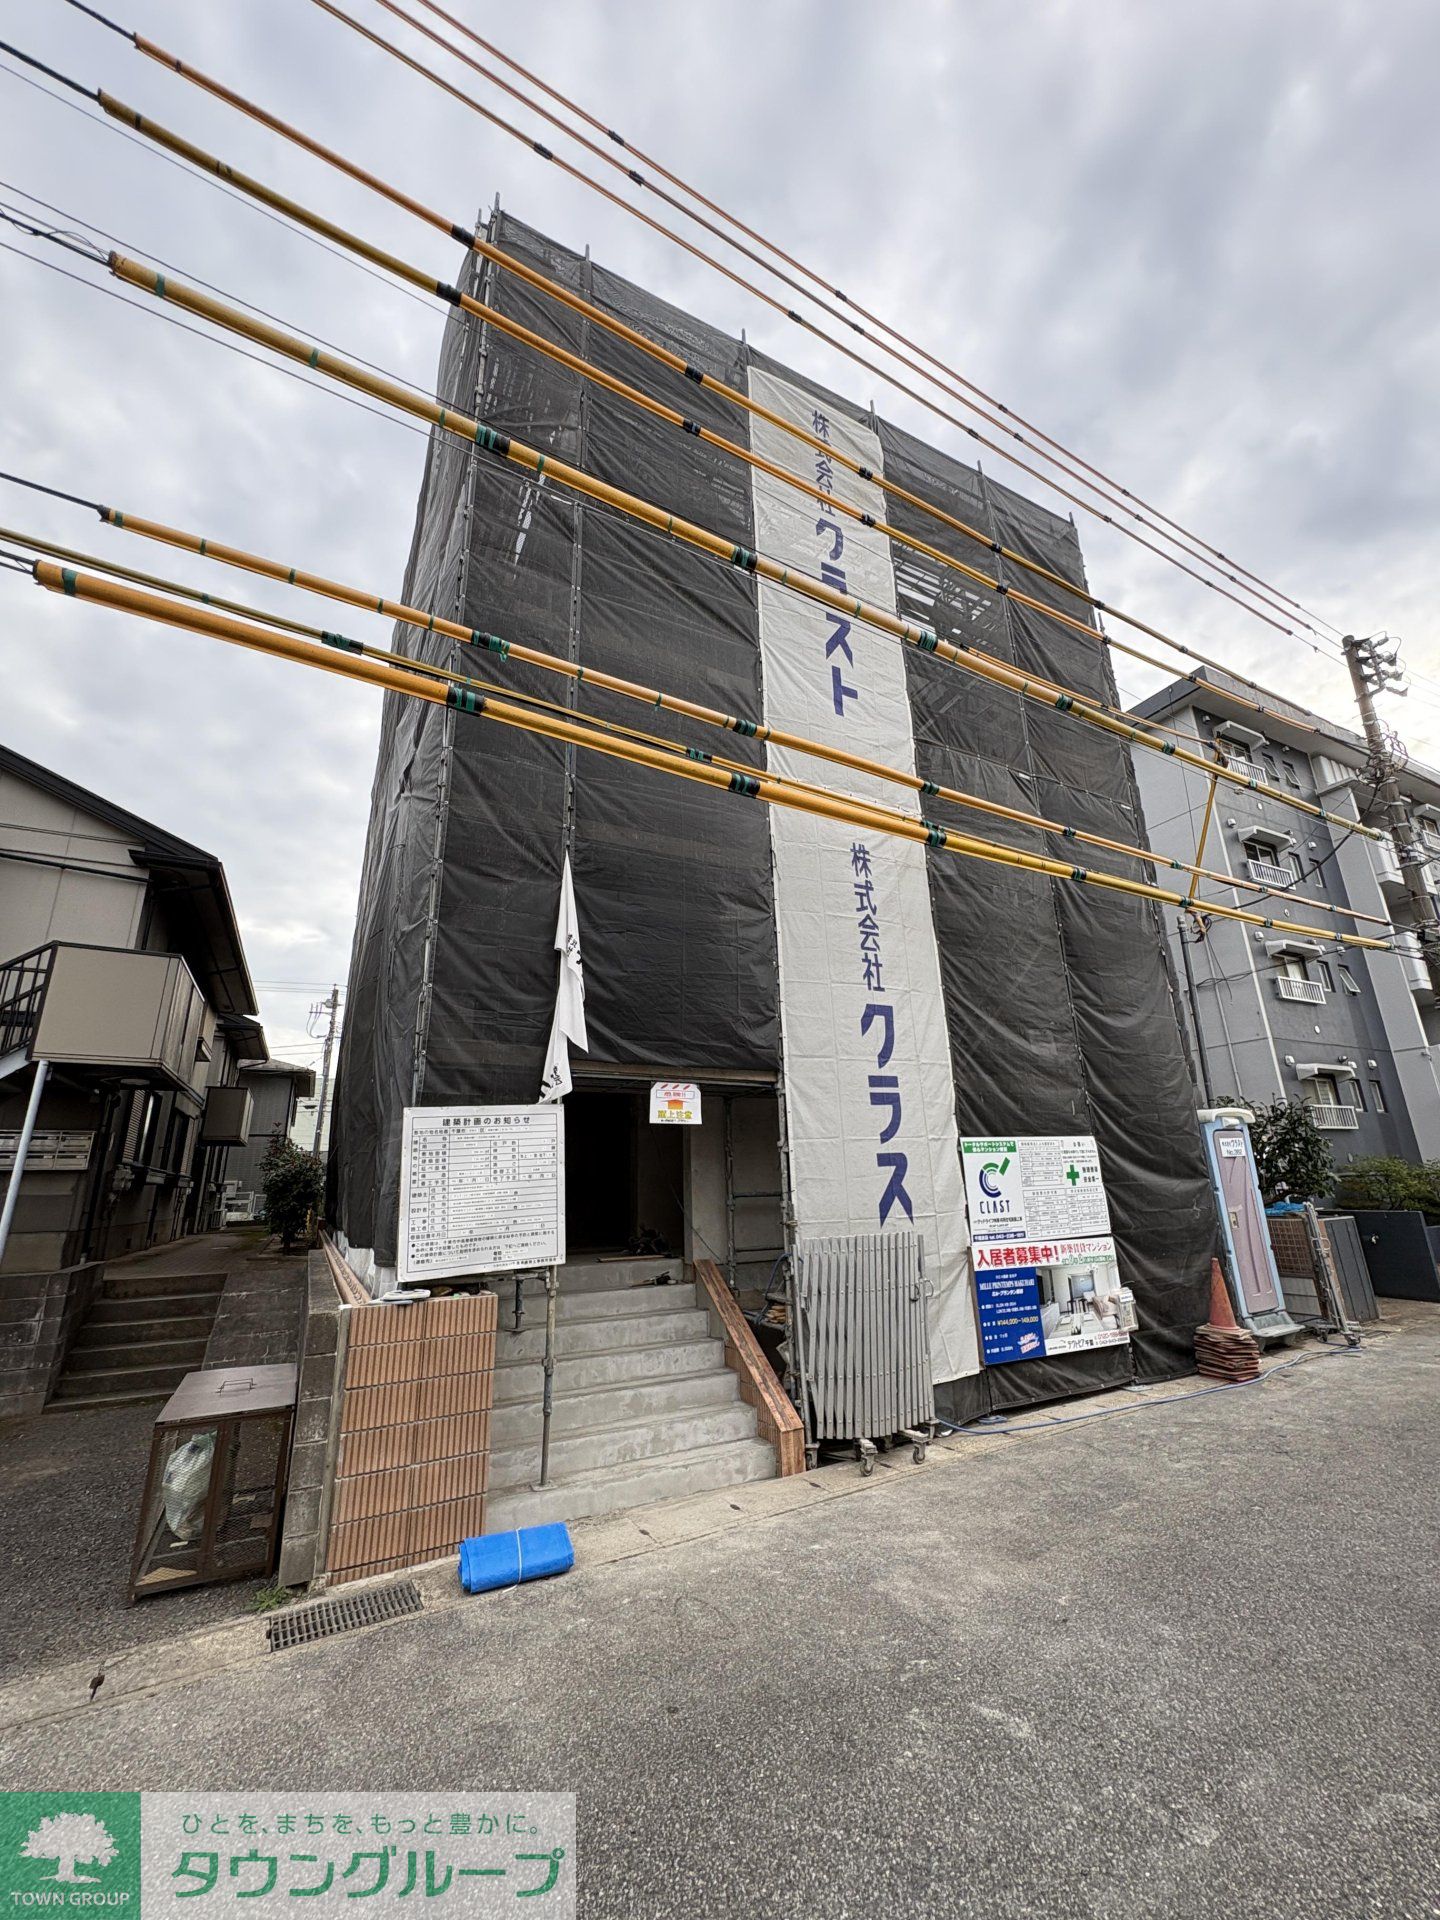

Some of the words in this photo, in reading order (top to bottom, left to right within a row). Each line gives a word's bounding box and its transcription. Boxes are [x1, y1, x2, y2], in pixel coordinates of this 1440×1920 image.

[442, 1116, 531, 1126] 建築計画のお知らせ
[979, 1200, 1010, 1214] CLAST
[978, 1244, 1060, 1268] 入居者募集中!
